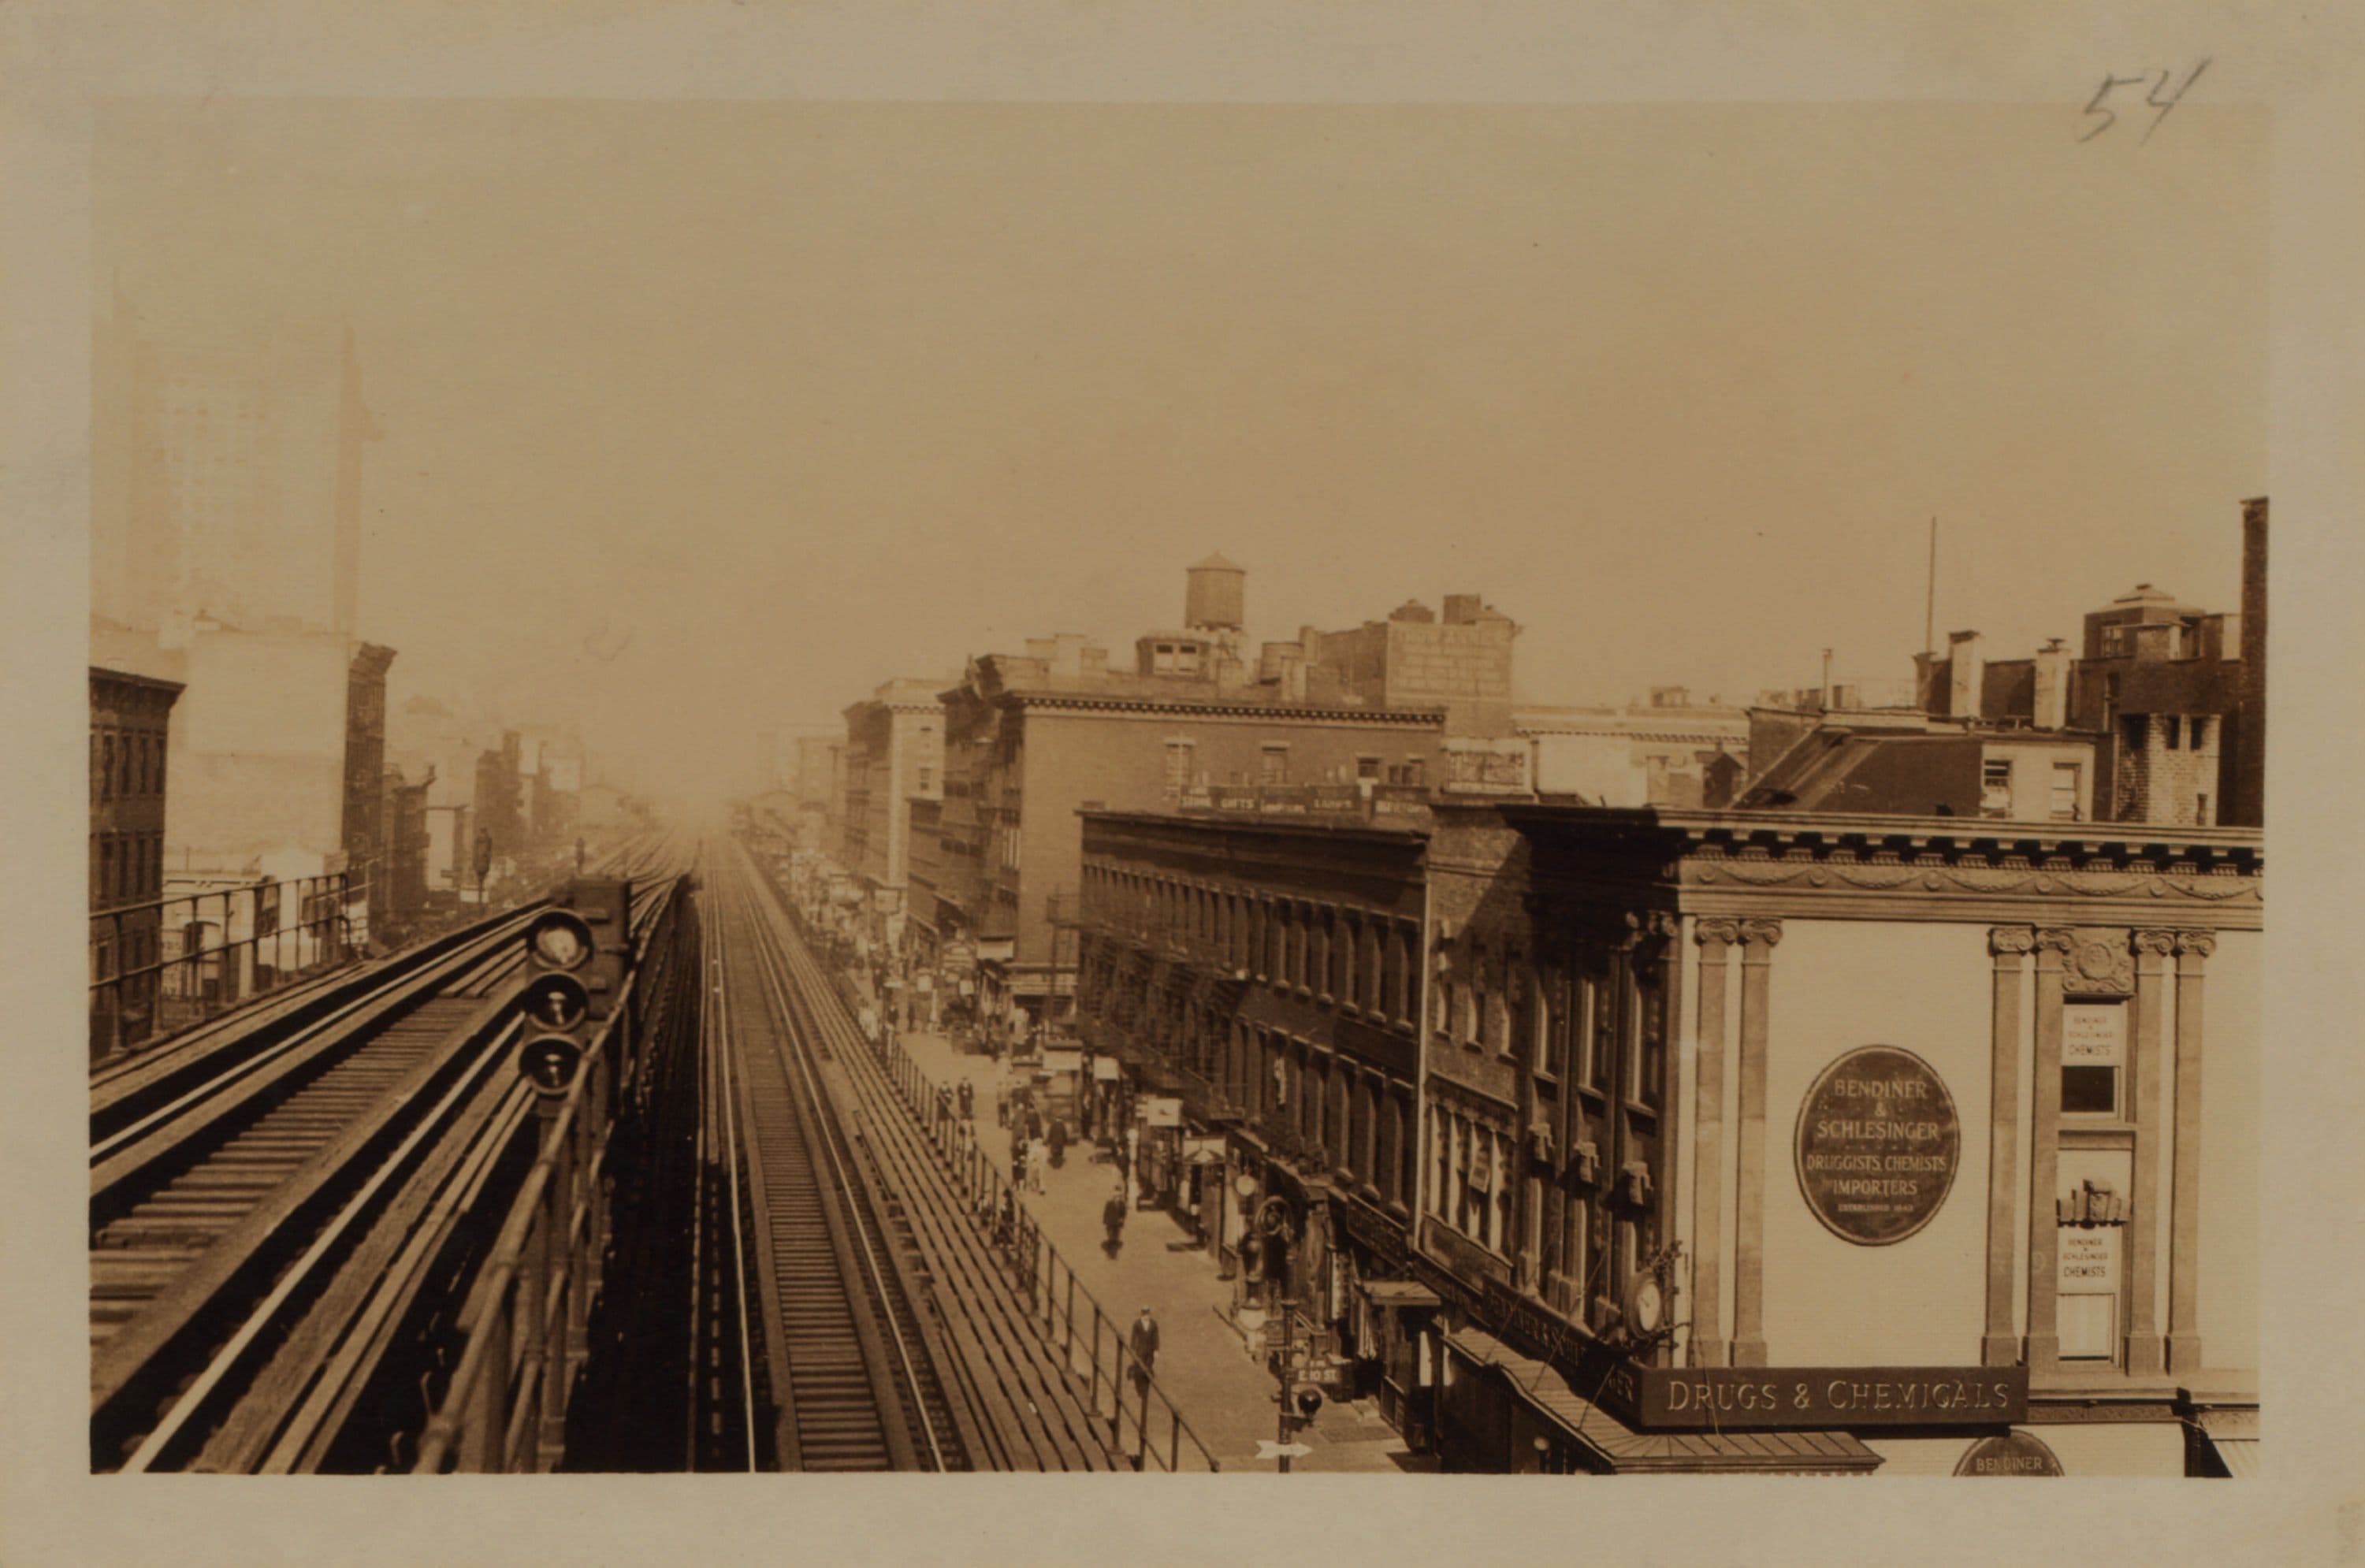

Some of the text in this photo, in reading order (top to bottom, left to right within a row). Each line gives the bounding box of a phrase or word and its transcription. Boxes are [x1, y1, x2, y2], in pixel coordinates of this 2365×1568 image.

[2069, 54, 2214, 147] 54
[1834, 1079, 1929, 1100] BENDINER
[1874, 1102, 1886, 1117] &
[1817, 1120, 1942, 1141] SCHLESINGER
[1885, 1155, 1947, 1172] CHEMISTS
[1833, 1180, 1918, 1196] IMPORTERS
[2063, 1265, 2107, 1278] CHEMISTS
[1667, 1379, 2010, 1411] DRUGS & CHEMICALS
[1976, 1456, 2043, 1472] BENDINER
